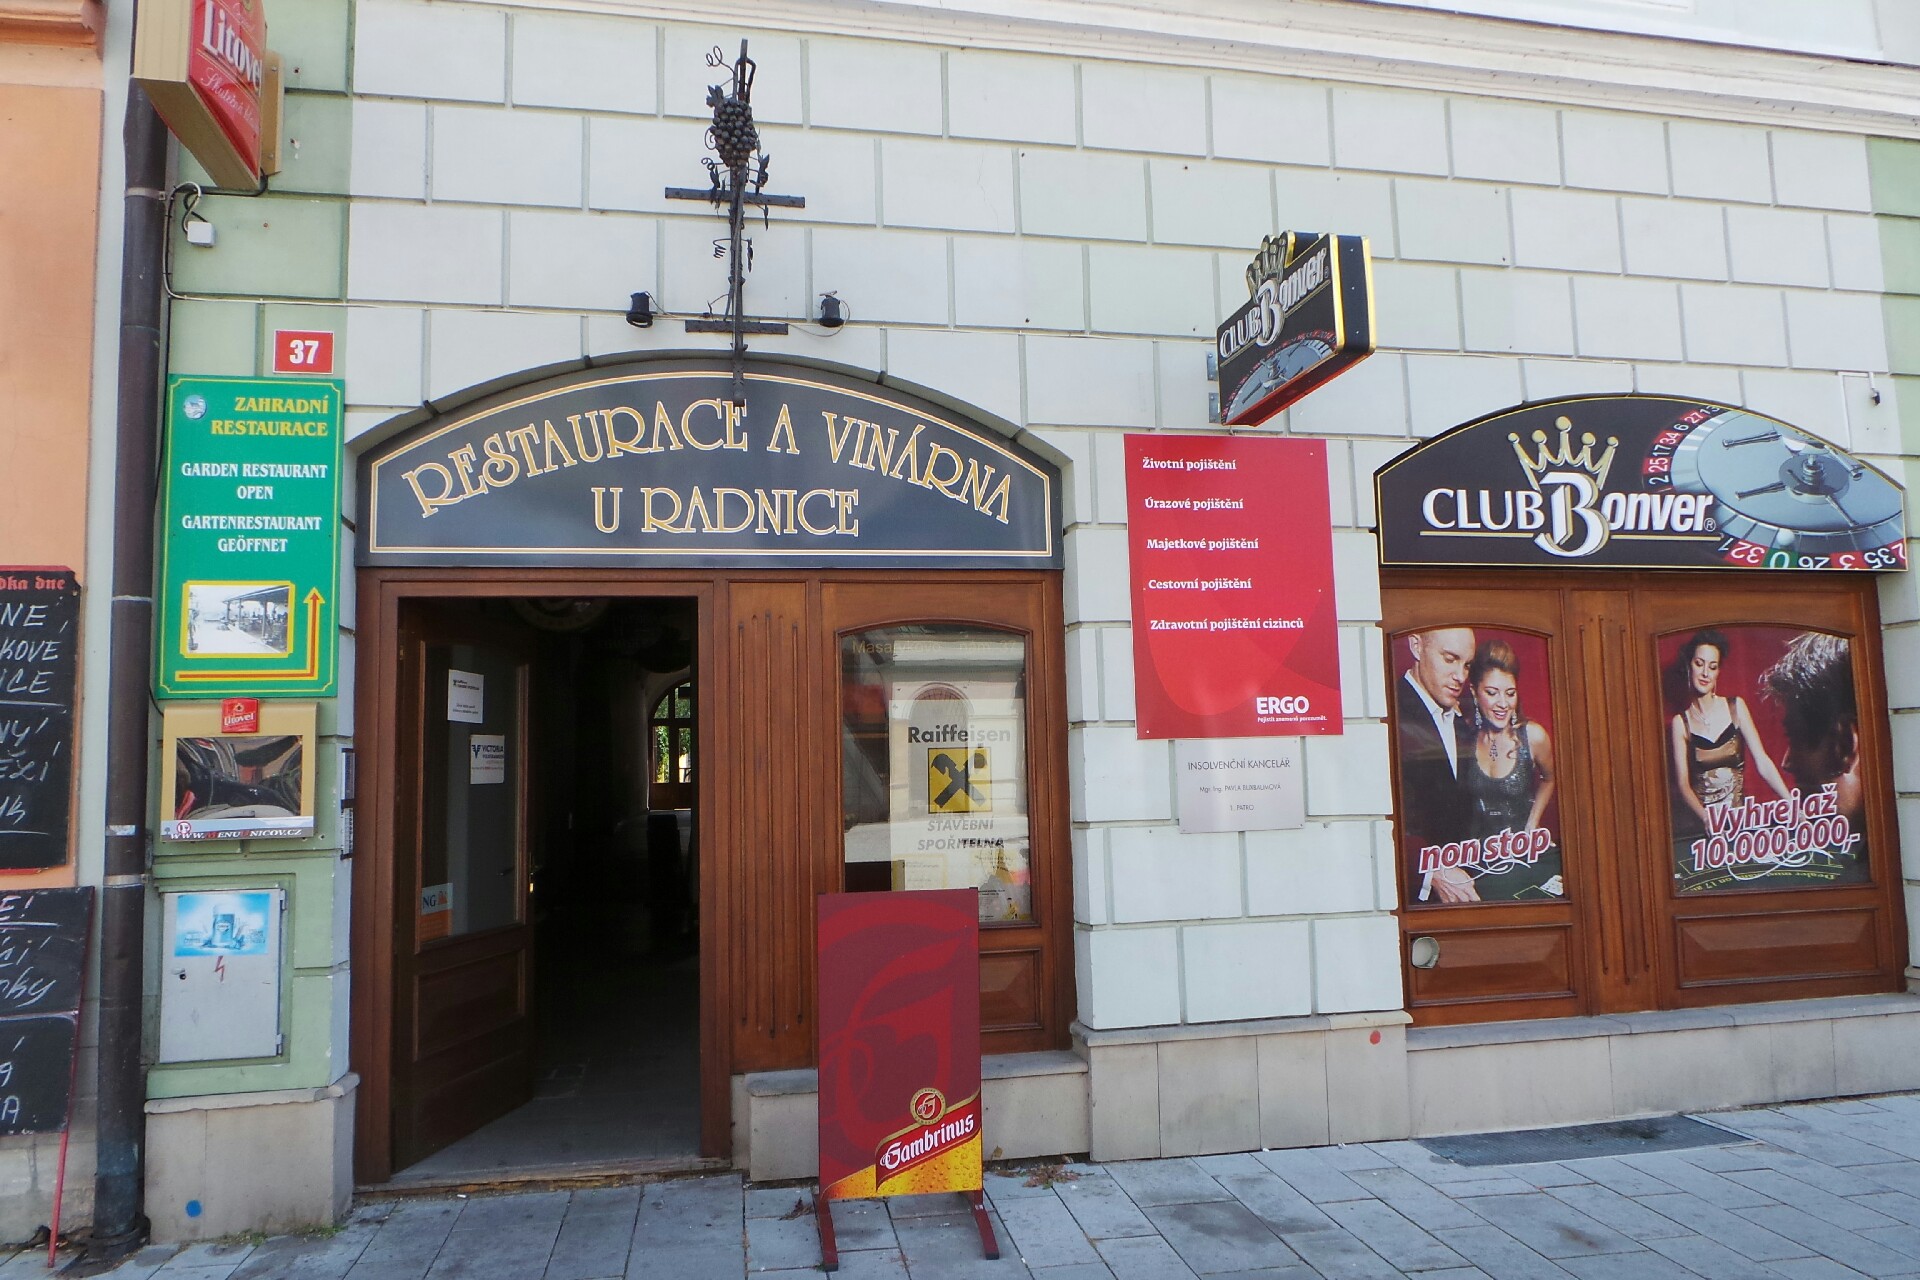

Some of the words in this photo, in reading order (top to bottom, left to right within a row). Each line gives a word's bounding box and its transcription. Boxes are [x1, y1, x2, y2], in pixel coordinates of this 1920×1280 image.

[1219, 305, 1262, 358] CLUB
[289, 339, 319, 365] 37
[234, 395, 329, 414] ZAHRADNÍ
[211, 420, 329, 437] RESTAURACE
[401, 398, 748, 518] RESTAURACE
[766, 403, 800, 454] A
[822, 411, 1011, 525] VINÁRNA
[1142, 457, 1184, 469] Životní
[1186, 459, 1237, 472] pojištění
[181, 462, 239, 478] GARDEN
[242, 463, 328, 479] RESTAURANT
[236, 485, 274, 500] OPEN
[591, 487, 623, 533] U
[640, 486, 859, 537] RADNICE
[1144, 497, 1191, 509] Úrazové
[1193, 498, 1244, 511] pojištění
[1422, 488, 1546, 530] CLUB
[182, 515, 322, 531] GARTENRESTAURANT
[217, 535, 288, 553] GEÖFFNET
[1147, 538, 1207, 551] Majetkové
[1208, 538, 1259, 551] pojištění
[35, 576, 65, 590] dne
[1148, 579, 1199, 589] Cestovní
[1201, 578, 1252, 591] pojištění
[1151, 618, 1208, 630] Zdravotní
[1210, 618, 1261, 631] pojištění
[1262, 617, 1304, 629] cizinců
[1256, 695, 1310, 714] ERGO
[907, 724, 1012, 744] Raiffeisen
[1188, 758, 1246, 770] INSOLVENČNÍ
[1248, 757, 1290, 769] KANCELÁŘ
[1707, 788, 1801, 841] Vyhrej
[1803, 783, 1838, 818] až
[927, 816, 994, 832] STAVEBNÍ
[917, 836, 1005, 851] SPOŘITELNA
[1418, 839, 1481, 873] non
[1483, 827, 1551, 864] stop
[1691, 815, 1861, 871] 10.000.000,-
[880, 1113, 974, 1170] Gambrinus
